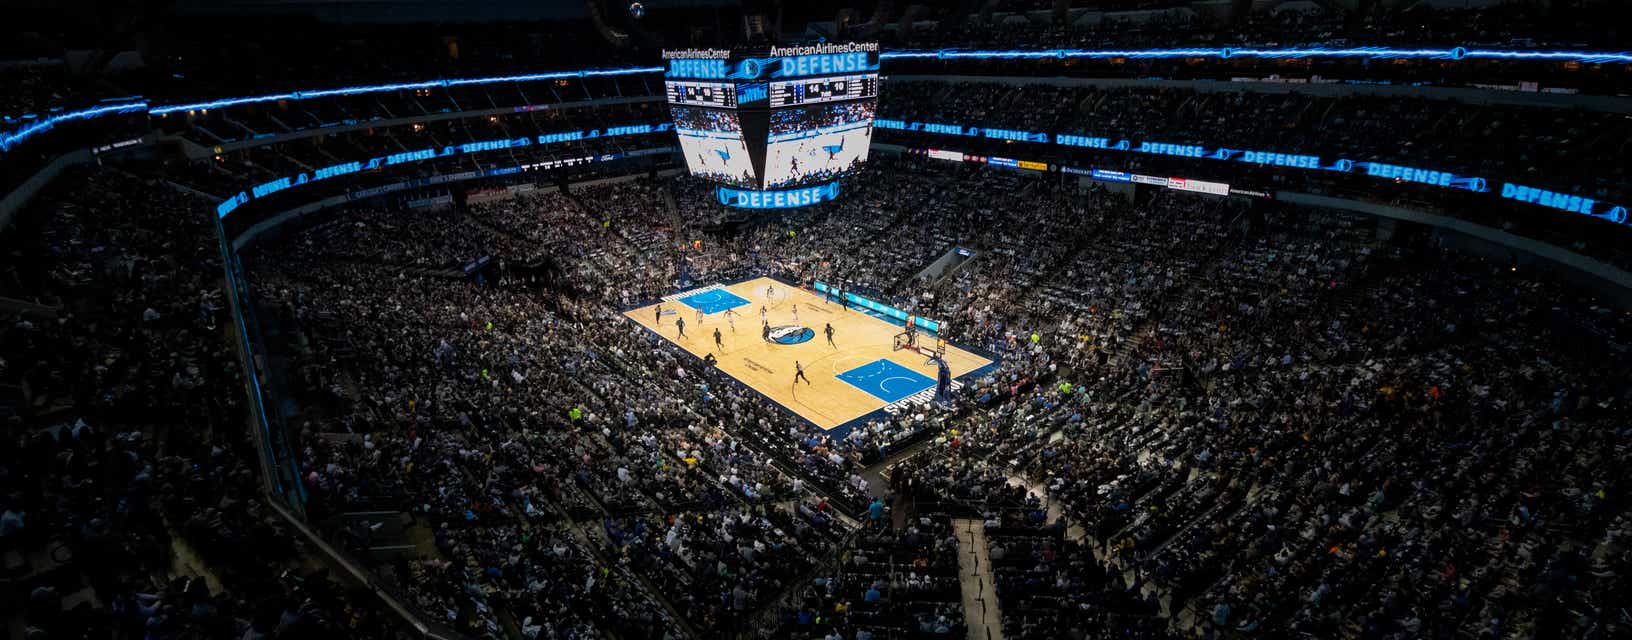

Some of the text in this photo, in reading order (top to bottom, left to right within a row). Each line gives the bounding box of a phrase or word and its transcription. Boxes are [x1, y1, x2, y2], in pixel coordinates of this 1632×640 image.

[662, 48, 730, 59] AmericanAirlinesCenter
[770, 42, 878, 57] AmericanAirlinesCenter
[671, 60, 725, 78] DEFENSE
[783, 53, 867, 76] DEFENSE
[809, 84, 819, 93] 14
[607, 125, 651, 136] DEFENSE
[925, 123, 962, 135] DEFENSE
[986, 128, 1028, 141] DEFENSE
[538, 131, 583, 144] DEFENSE
[1057, 134, 1108, 148] DEFENSE
[463, 139, 511, 153] DEFENSE
[1141, 141, 1203, 157] DEFENSE
[387, 148, 435, 165] DEFENSE
[601, 154, 614, 162] Ford
[1244, 151, 1320, 168] DEFENSE
[314, 161, 361, 179] DEFENSE
[1368, 162, 1451, 186] DEFENSE
[738, 188, 821, 207] DEFENSE
[1502, 182, 1594, 214] DEFENSE
